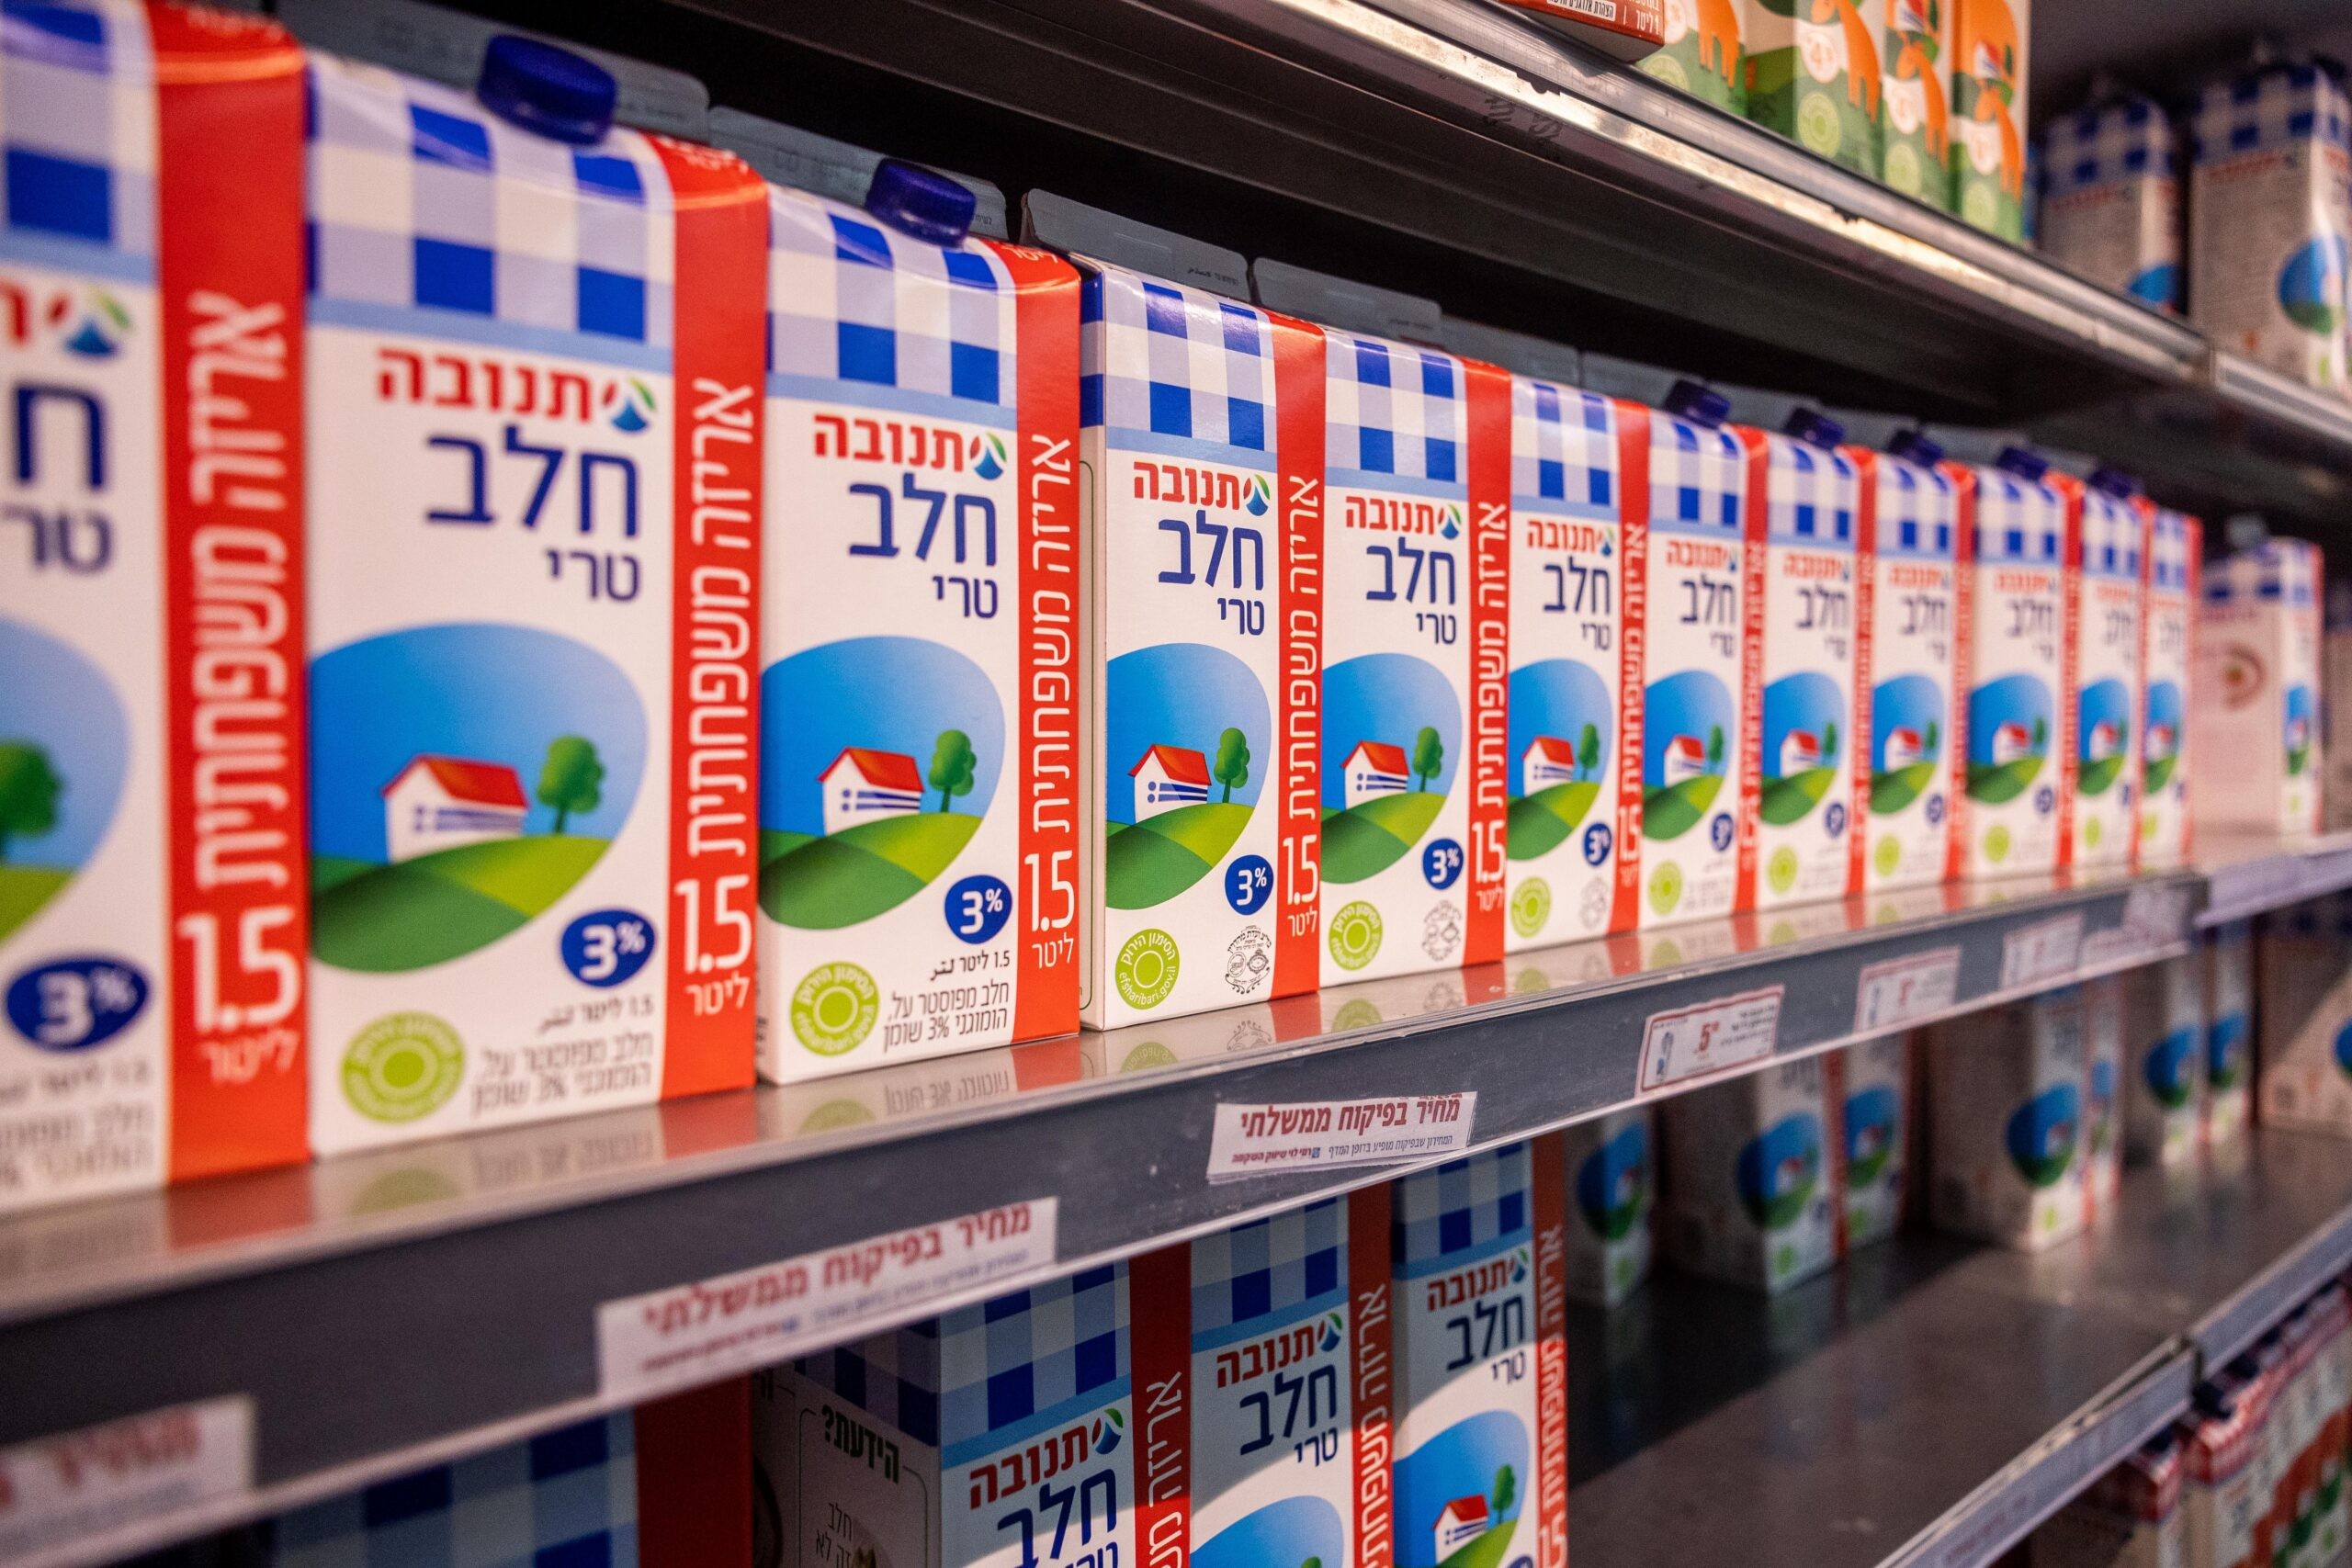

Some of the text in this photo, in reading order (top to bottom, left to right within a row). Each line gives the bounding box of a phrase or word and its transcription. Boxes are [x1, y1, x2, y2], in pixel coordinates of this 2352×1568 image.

[1635, 9, 1653, 33] ליטר
[377, 347, 593, 423] תנובה
[815, 414, 964, 472] תנובה
[425, 423, 640, 539] חלב
[1134, 461, 1239, 511] תנובה
[0, 506, 114, 574] טר
[849, 472, 996, 567] חלב
[1346, 496, 1434, 535] תנובה
[1527, 519, 1595, 554] תנובה
[548, 550, 640, 603] טרי
[1159, 510, 1263, 591] חלב
[1366, 536, 1454, 604] חלב
[189, 290, 289, 888] אריזה משפחתית
[932, 576, 998, 618] טרי
[1544, 555, 1611, 615] חלב
[1681, 573, 1735, 625] חלב
[688, 378, 754, 857] אריזה משפחתית
[1032, 434, 1071, 833] אריזה משפחתית
[1217, 598, 1264, 636] טרי
[1416, 613, 1456, 645] טרי
[1581, 622, 1611, 651] טרי
[1289, 475, 1319, 820] אריזה משפחתית
[1477, 502, 1507, 809] אריזה משפחתית
[1283, 834, 1318, 906] 1.5
[1431, 847, 1460, 884] 3%
[1472, 819, 1506, 884] 1.5
[960, 888, 1003, 934] 3%
[1024, 850, 1075, 931] 1.5
[1237, 866, 1267, 906] 3%
[1476, 884, 1504, 912] ליטר
[675, 875, 752, 974] 1.5
[1287, 906, 1317, 937] ליטר
[177, 906, 300, 1033] 1.5
[580, 921, 646, 980] 3%
[959, 950, 989, 973] ליטר
[994, 950, 1011, 969] 1.5
[1032, 932, 1074, 969] ליטר
[1121, 931, 1176, 965] הסימון הירוק
[685, 973, 751, 1017] ליטר
[919, 987, 976, 1015] מפוסטר
[980, 978, 1010, 1007] חלב
[1119, 965, 1176, 1005] efsharibari.gov.il
[883, 1020, 922, 1054] שומן
[928, 1016, 950, 1041] 3%
[956, 1007, 1008, 1036] הומוגני
[200, 1031, 301, 1086] ליטר
[1241, 1099, 1461, 1139] מחיר בפיקוח ממשלתי
[957, 1203, 1032, 1249] מחיר
[825, 1226, 943, 1288] בפיקוח
[645, 1263, 808, 1336] ממשלתי
[1427, 1261, 1509, 1312] תנובה
[1216, 1325, 1314, 1388] תנובה
[1446, 1293, 1525, 1372] חלב
[1491, 1352, 1526, 1384] טרי
[1239, 1363, 1337, 1456] חלב
[1359, 1284, 1388, 1568] אריזה משפחת
[820, 1404, 899, 1485] הידעת?
[1146, 1371, 1182, 1508] אריזה
[1294, 1427, 1339, 1468] טרי
[969, 1425, 1088, 1510] תנובה
[827, 1502, 853, 1541] חלב
[998, 1469, 1117, 1568] חלב
[815, 1529, 831, 1561] לא
